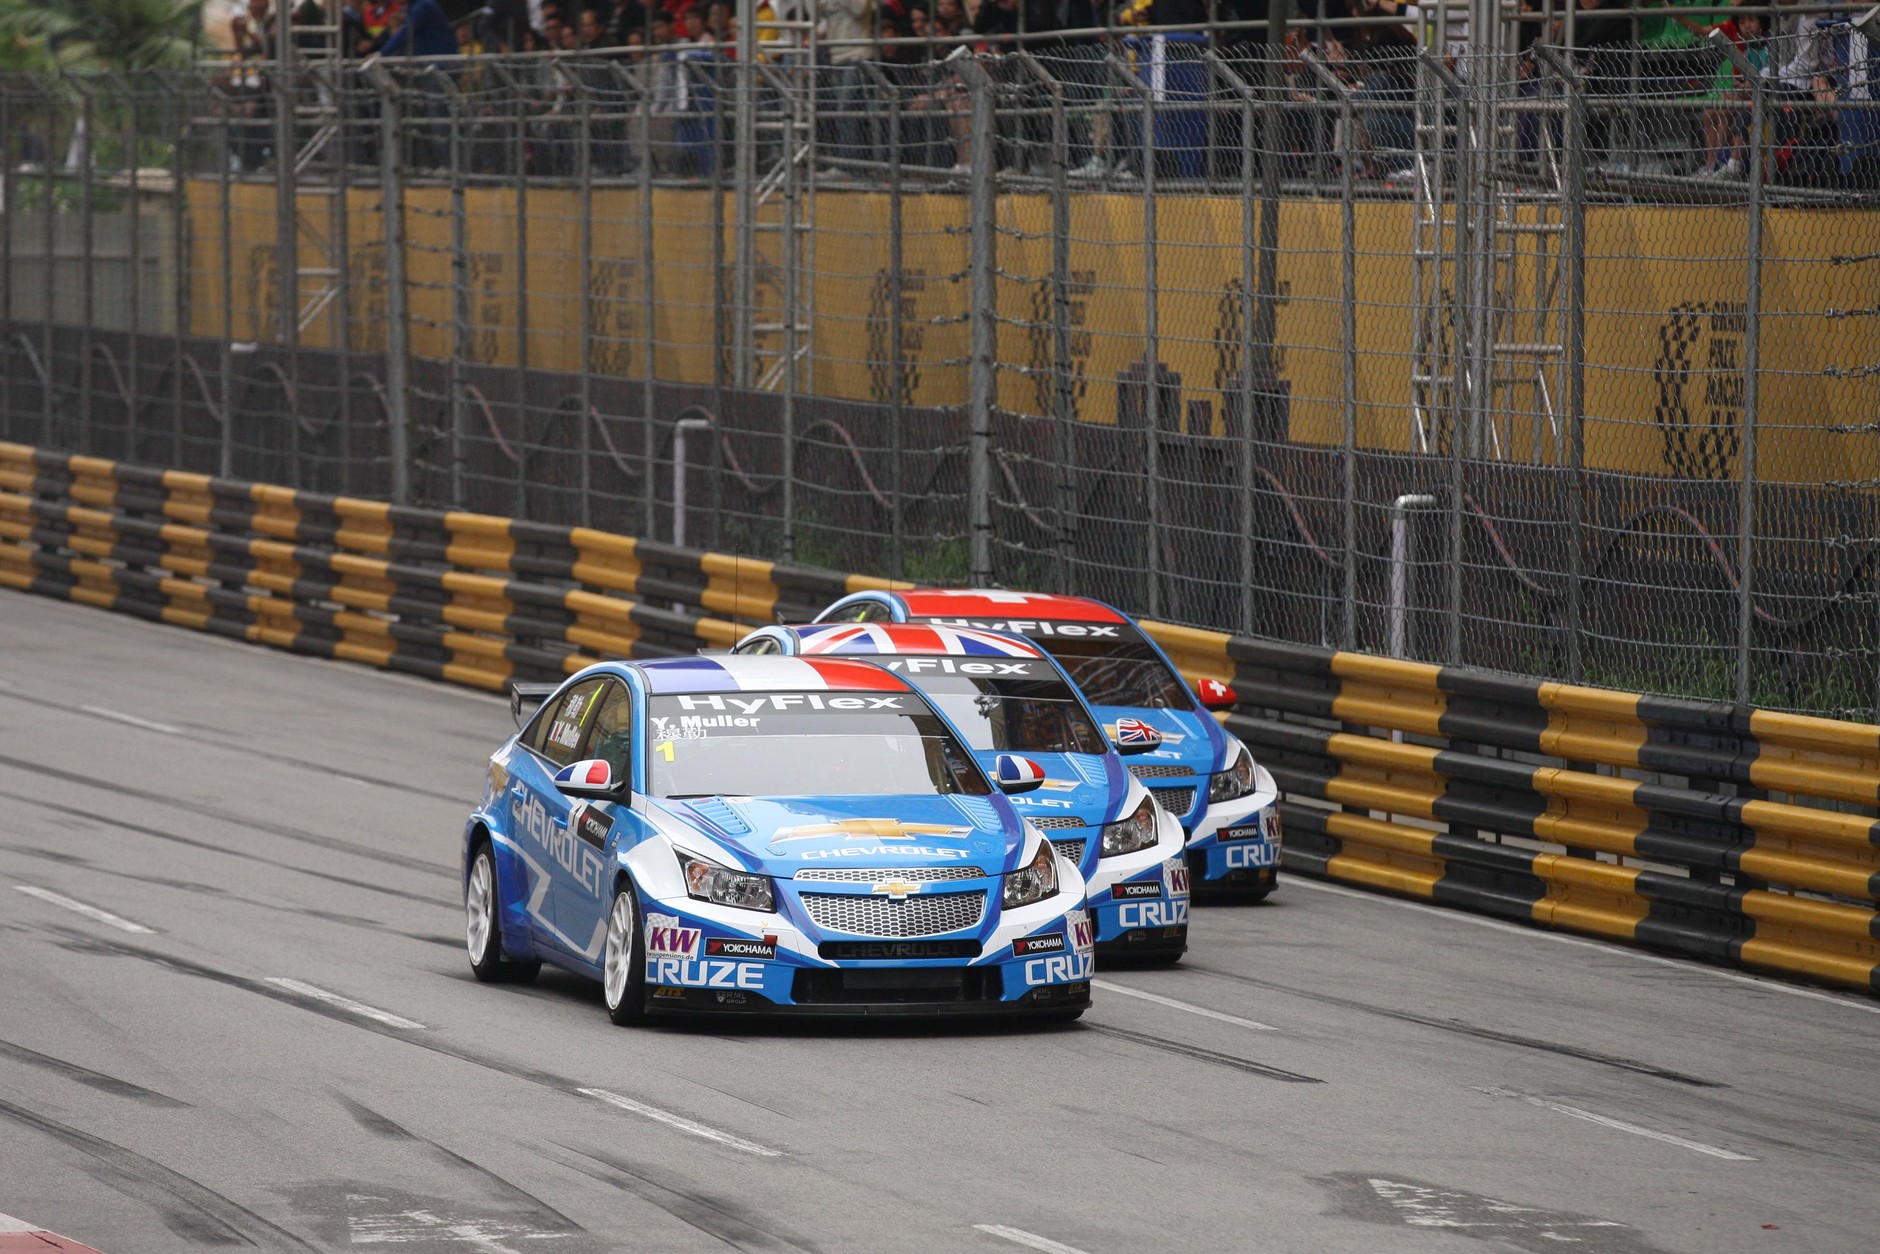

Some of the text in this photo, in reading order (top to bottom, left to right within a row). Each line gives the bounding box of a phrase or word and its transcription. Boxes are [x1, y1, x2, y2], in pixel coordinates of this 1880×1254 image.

[677, 694, 904, 714] HyFlex
[680, 715, 761, 728] Muller
[655, 740, 675, 762] 1
[512, 780, 604, 899] CHEVROLET
[1228, 828, 1258, 838] YOKOHAMA
[800, 845, 971, 861] CHEVROLET
[1125, 885, 1160, 896] YOKOHAMA
[1119, 900, 1190, 927] CRUZ
[650, 926, 699, 953] KW
[723, 943, 773, 955] YOKOHAMA
[1027, 937, 1063, 950] YOKOHAMA
[646, 958, 765, 989] CRUZE
[1025, 951, 1094, 986] CRUZ
